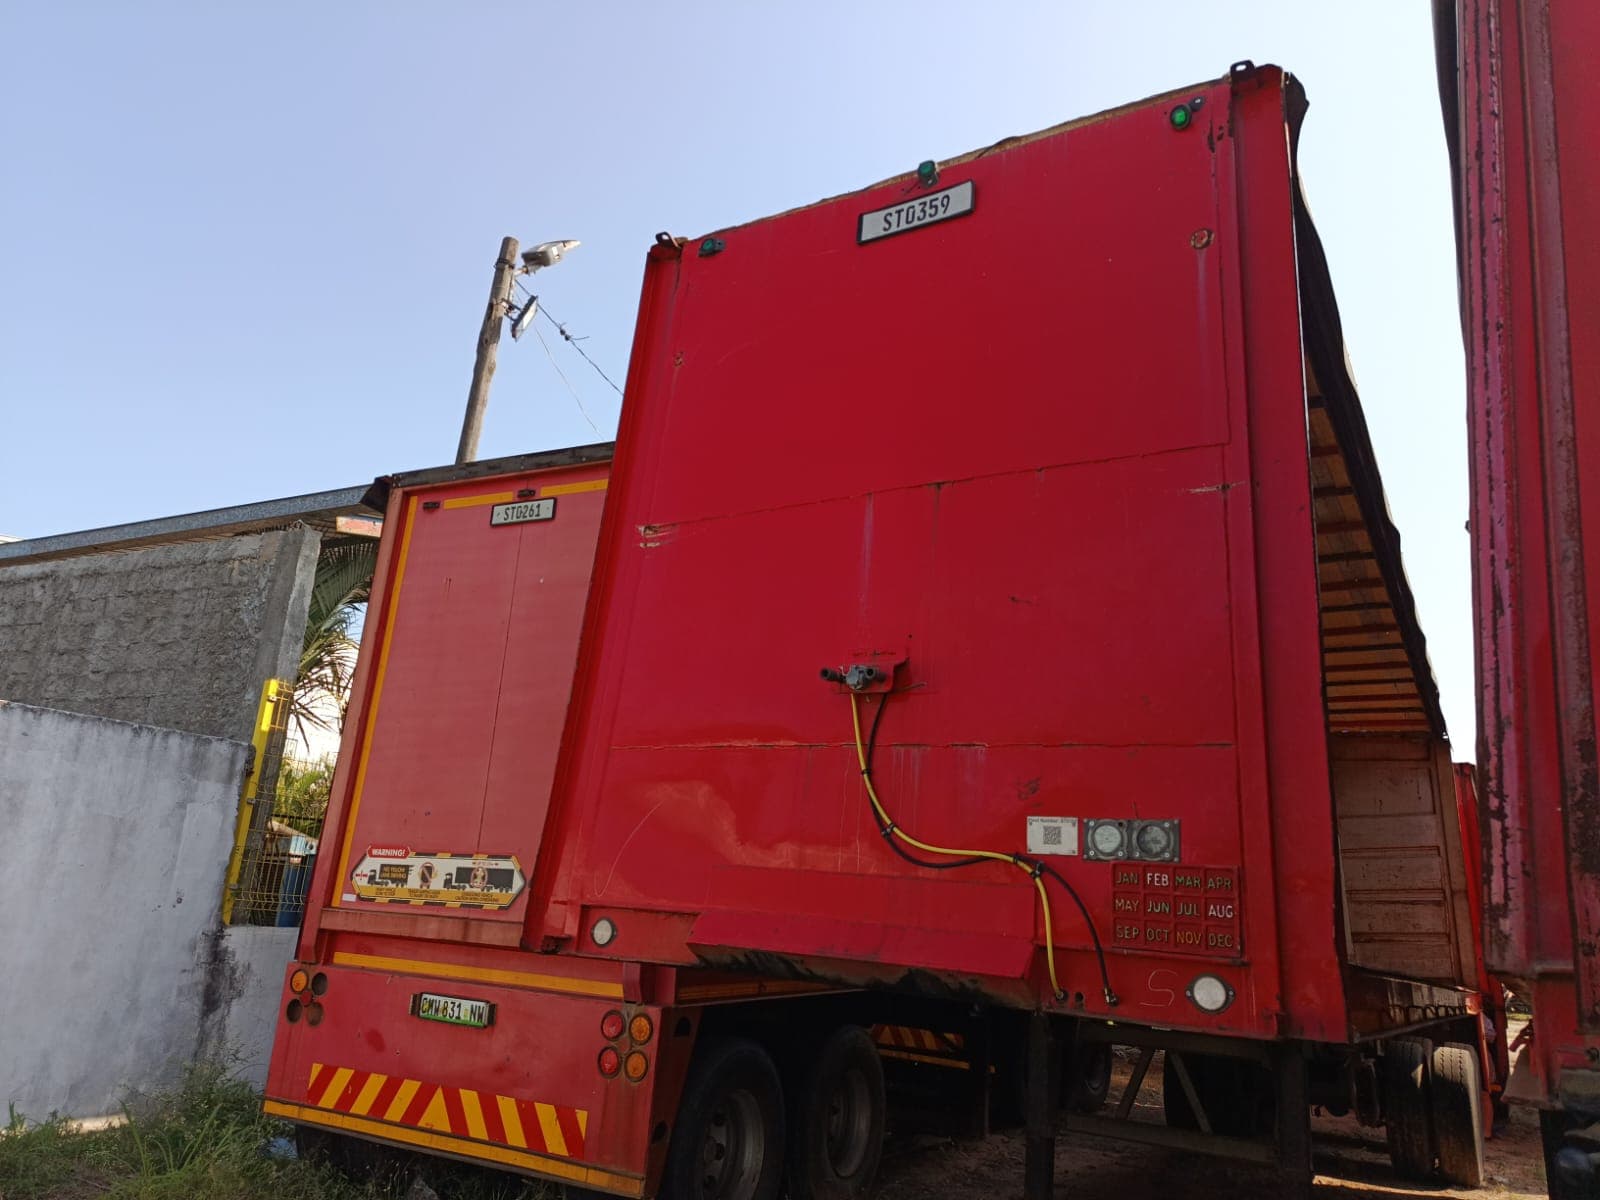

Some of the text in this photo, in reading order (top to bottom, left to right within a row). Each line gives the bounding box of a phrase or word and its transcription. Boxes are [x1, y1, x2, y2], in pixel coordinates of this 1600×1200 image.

[371, 848, 405, 857] WARNING!
[1115, 872, 1232, 890] JAN FEB MAR APR
[1115, 898, 1234, 918] MAY JUN JUL AUG
[1116, 925, 1233, 947] SEP OCT NOV DEC
[442, 1000, 462, 1020] 831
[469, 1003, 485, 1023] NW
